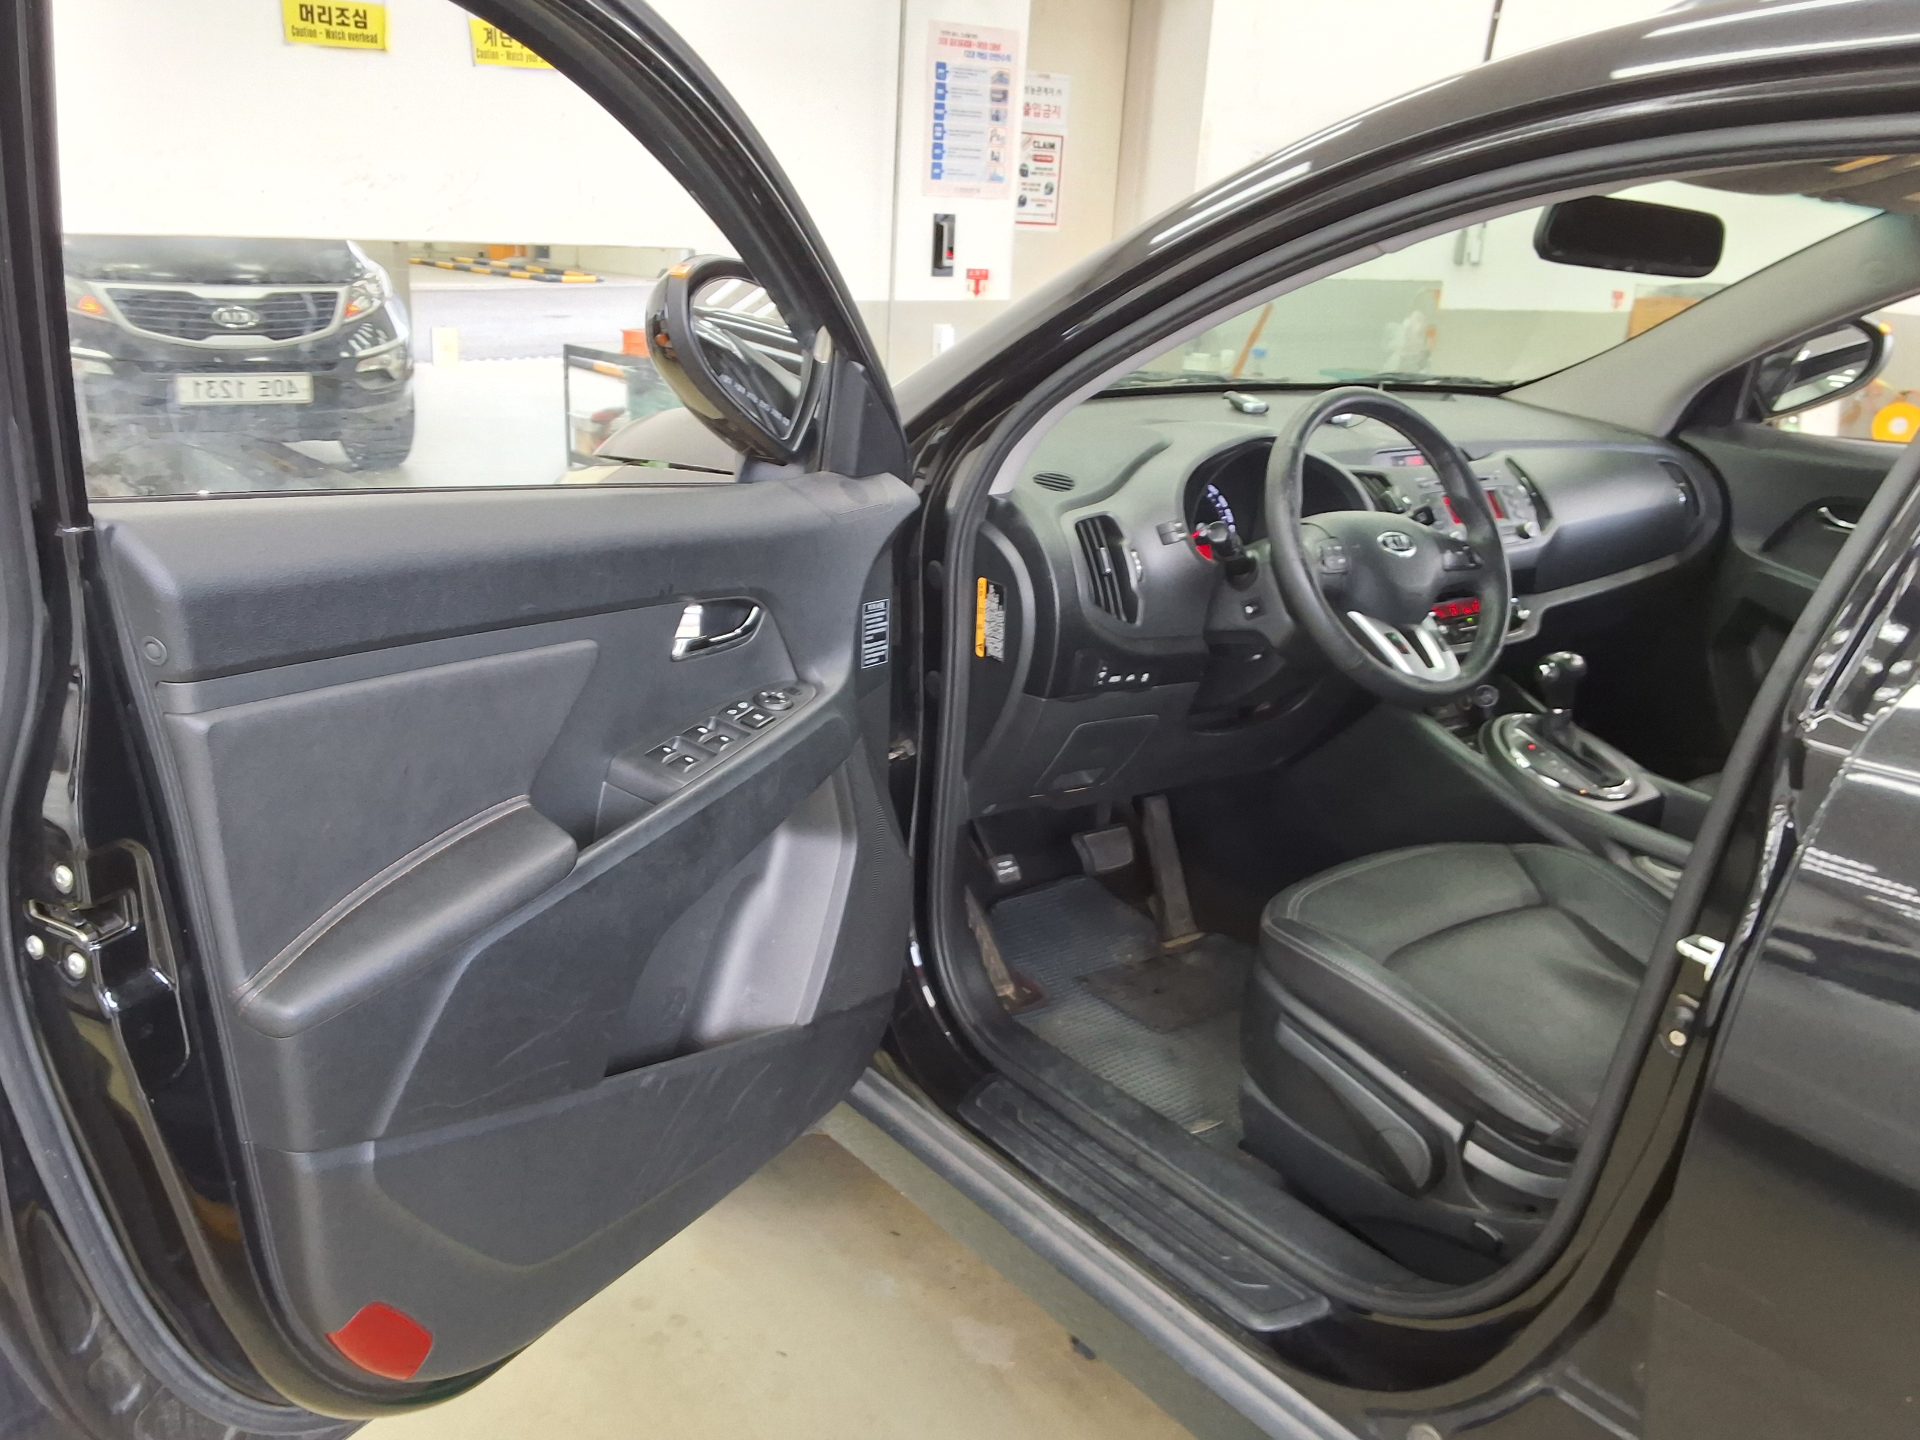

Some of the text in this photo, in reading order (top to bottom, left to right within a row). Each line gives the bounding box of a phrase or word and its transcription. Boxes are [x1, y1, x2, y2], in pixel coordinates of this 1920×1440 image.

[299, 3, 368, 29] 머리조심
[291, 25, 317, 38] Caution
[325, 29, 346, 40] Watch
[348, 32, 378, 44] overhead
[1033, 140, 1056, 149] CLAIM
